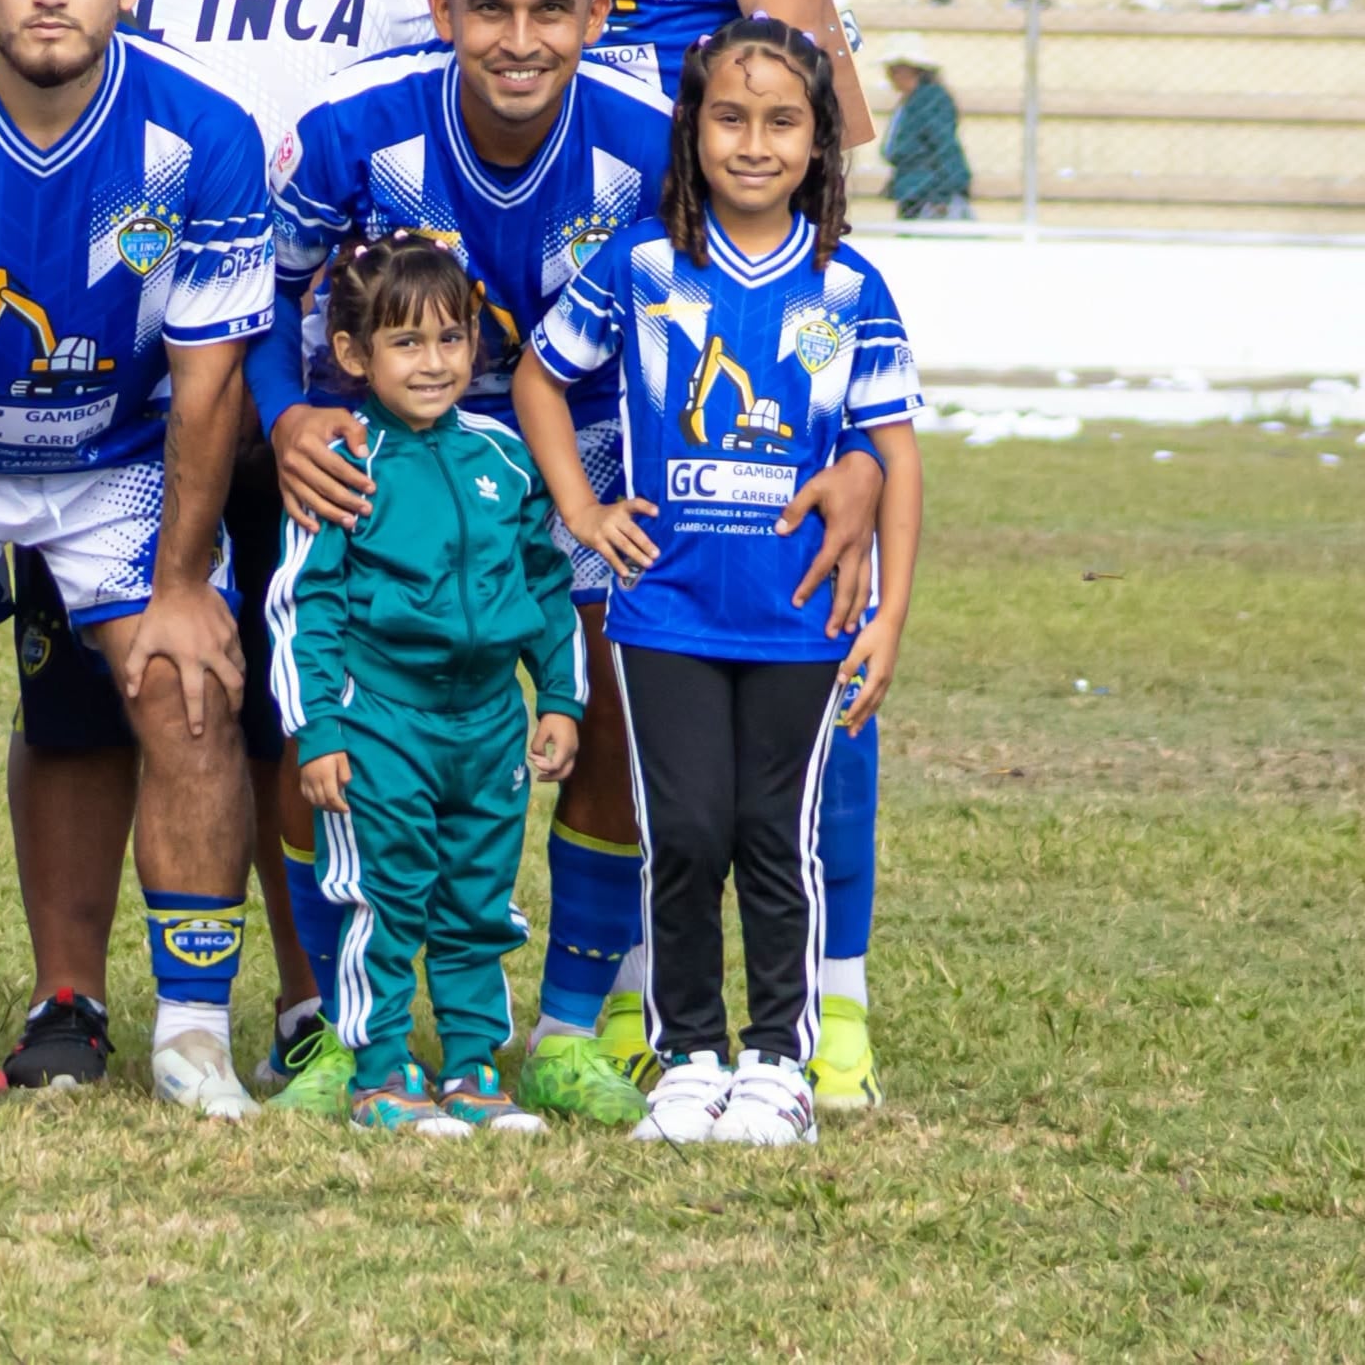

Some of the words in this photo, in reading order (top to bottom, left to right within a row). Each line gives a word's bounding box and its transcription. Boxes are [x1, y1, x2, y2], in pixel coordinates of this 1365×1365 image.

[25, 399, 111, 422] GAMBOA
[23, 422, 104, 445] CARRERA
[671, 464, 717, 497] GC
[733, 465, 794, 481] GAMBOA
[732, 489, 789, 504] CARRERA
[674, 522, 713, 534] GAMBOA
[714, 523, 765, 536] CARRERA
[192, 936, 234, 946] INCA
